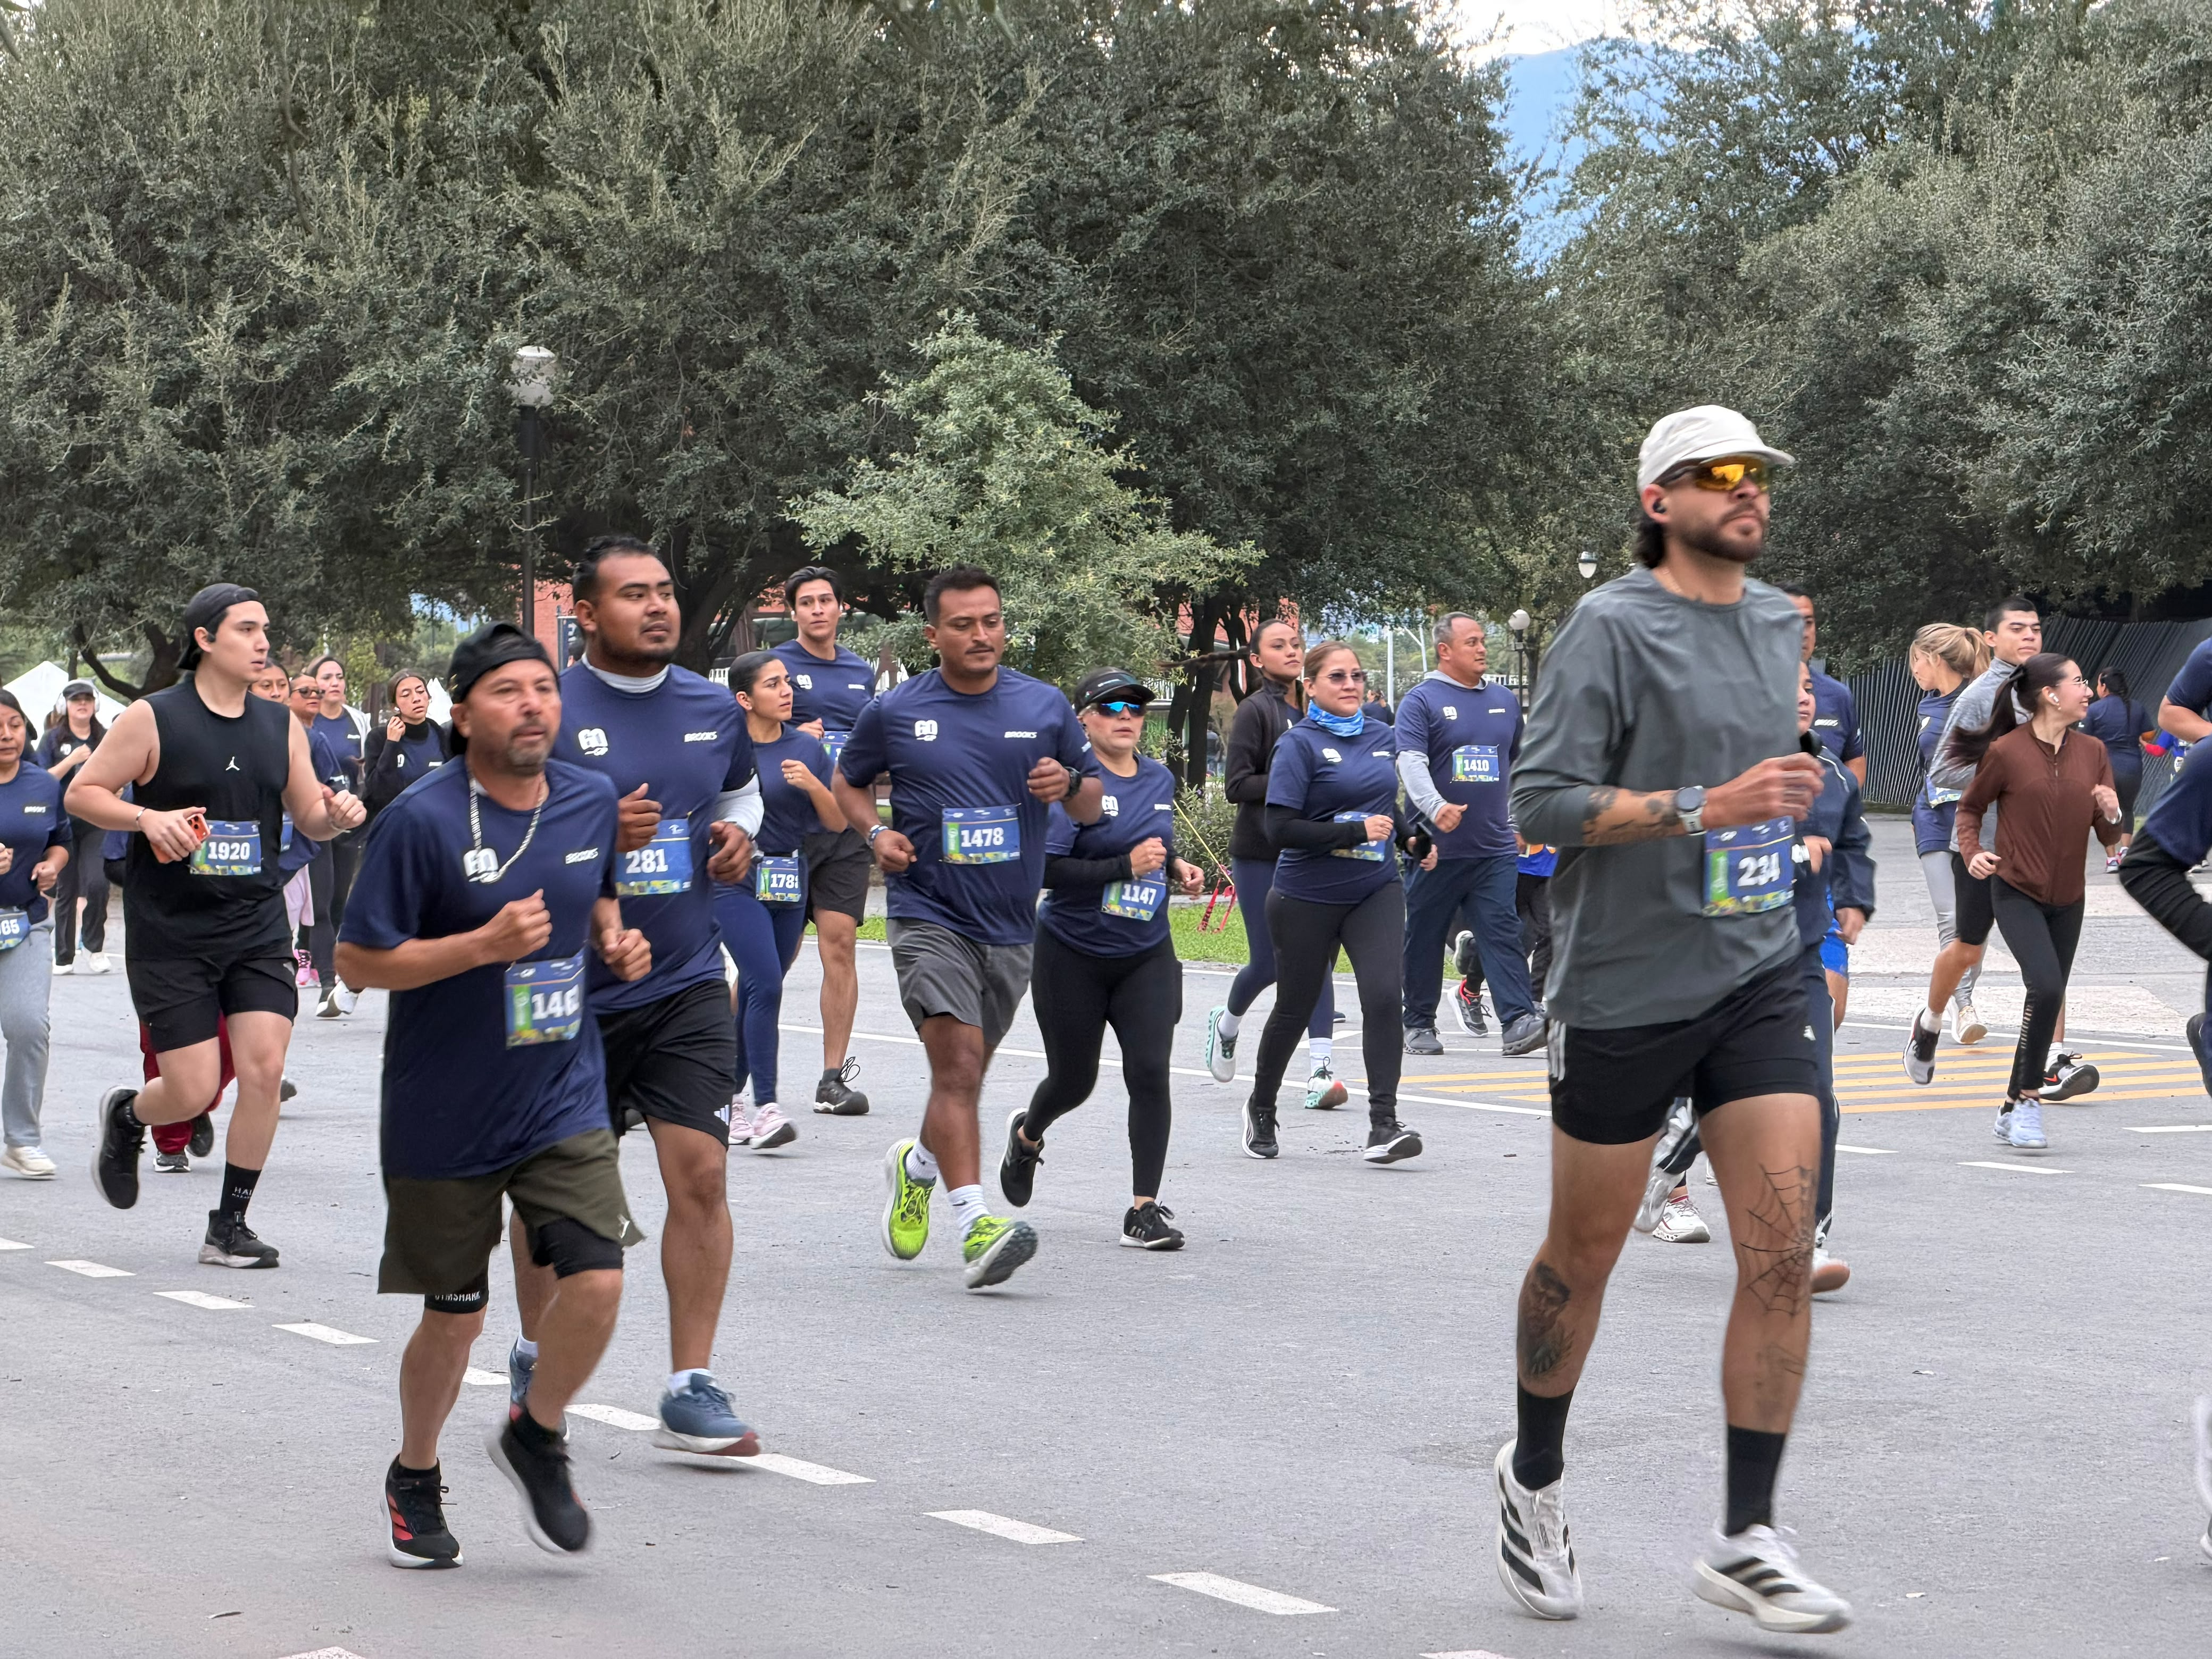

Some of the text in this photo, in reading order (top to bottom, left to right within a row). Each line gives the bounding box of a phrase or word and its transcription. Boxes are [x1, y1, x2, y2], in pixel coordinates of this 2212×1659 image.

[684, 731, 718, 742] BROOKS
[1463, 759, 1489, 772] 1410
[961, 827, 1004, 848] 1478
[207, 842, 250, 860] 1920
[565, 848, 599, 864] BROOKS
[625, 848, 668, 874] 281
[1121, 884, 1157, 906] 1147
